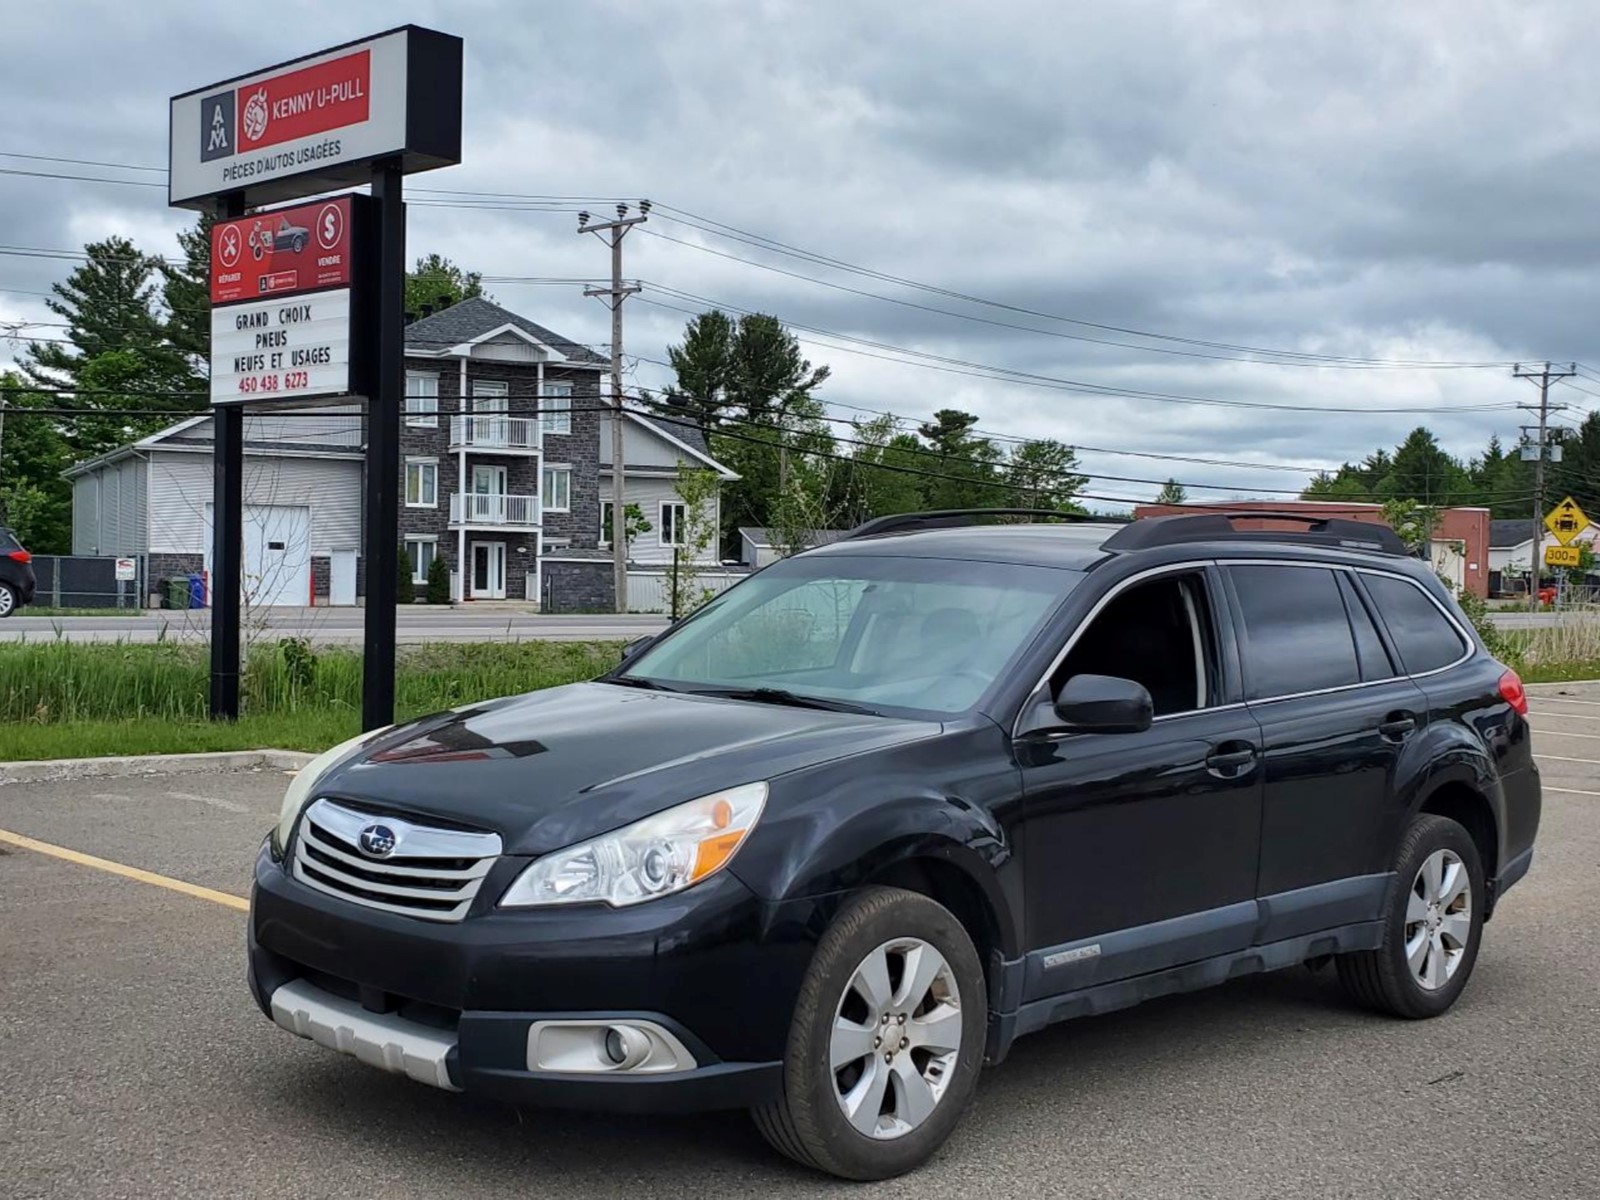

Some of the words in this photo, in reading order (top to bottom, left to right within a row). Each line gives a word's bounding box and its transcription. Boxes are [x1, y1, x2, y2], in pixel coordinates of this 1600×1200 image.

[272, 92, 314, 120] KENNY
[316, 78, 364, 108] U-PULL
[222, 159, 255, 182] PIÈCES
[257, 150, 295, 175] D'AUTOS
[296, 139, 341, 167] USAGÉES
[318, 254, 341, 267] VENDRE
[236, 311, 269, 330] GRAND
[279, 305, 311, 325] CHOIX
[256, 330, 287, 349] PNEUS
[234, 354, 265, 373] NEUFS
[271, 352, 283, 369] ET
[292, 346, 330, 367] USAGES
[239, 376, 257, 393] 450
[260, 375, 278, 390] 438
[285, 371, 308, 389] 6273
